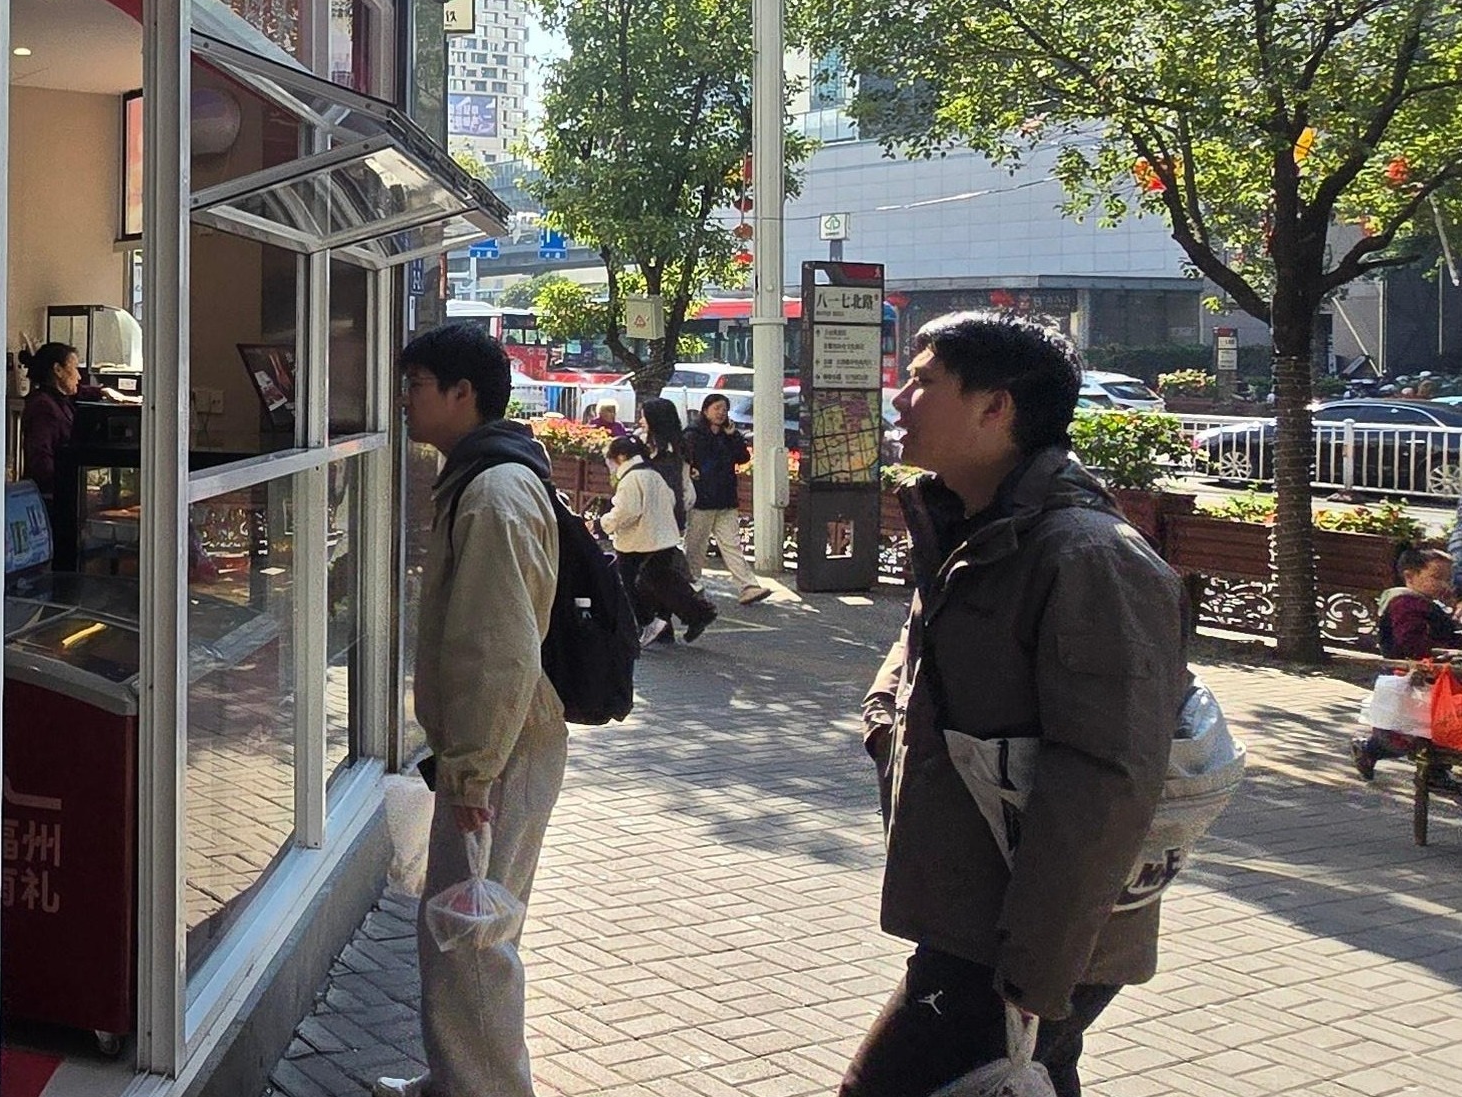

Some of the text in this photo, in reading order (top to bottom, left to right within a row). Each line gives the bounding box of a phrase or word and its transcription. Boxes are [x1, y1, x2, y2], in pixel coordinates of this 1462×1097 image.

[816, 293, 873, 310] 八一七北路
